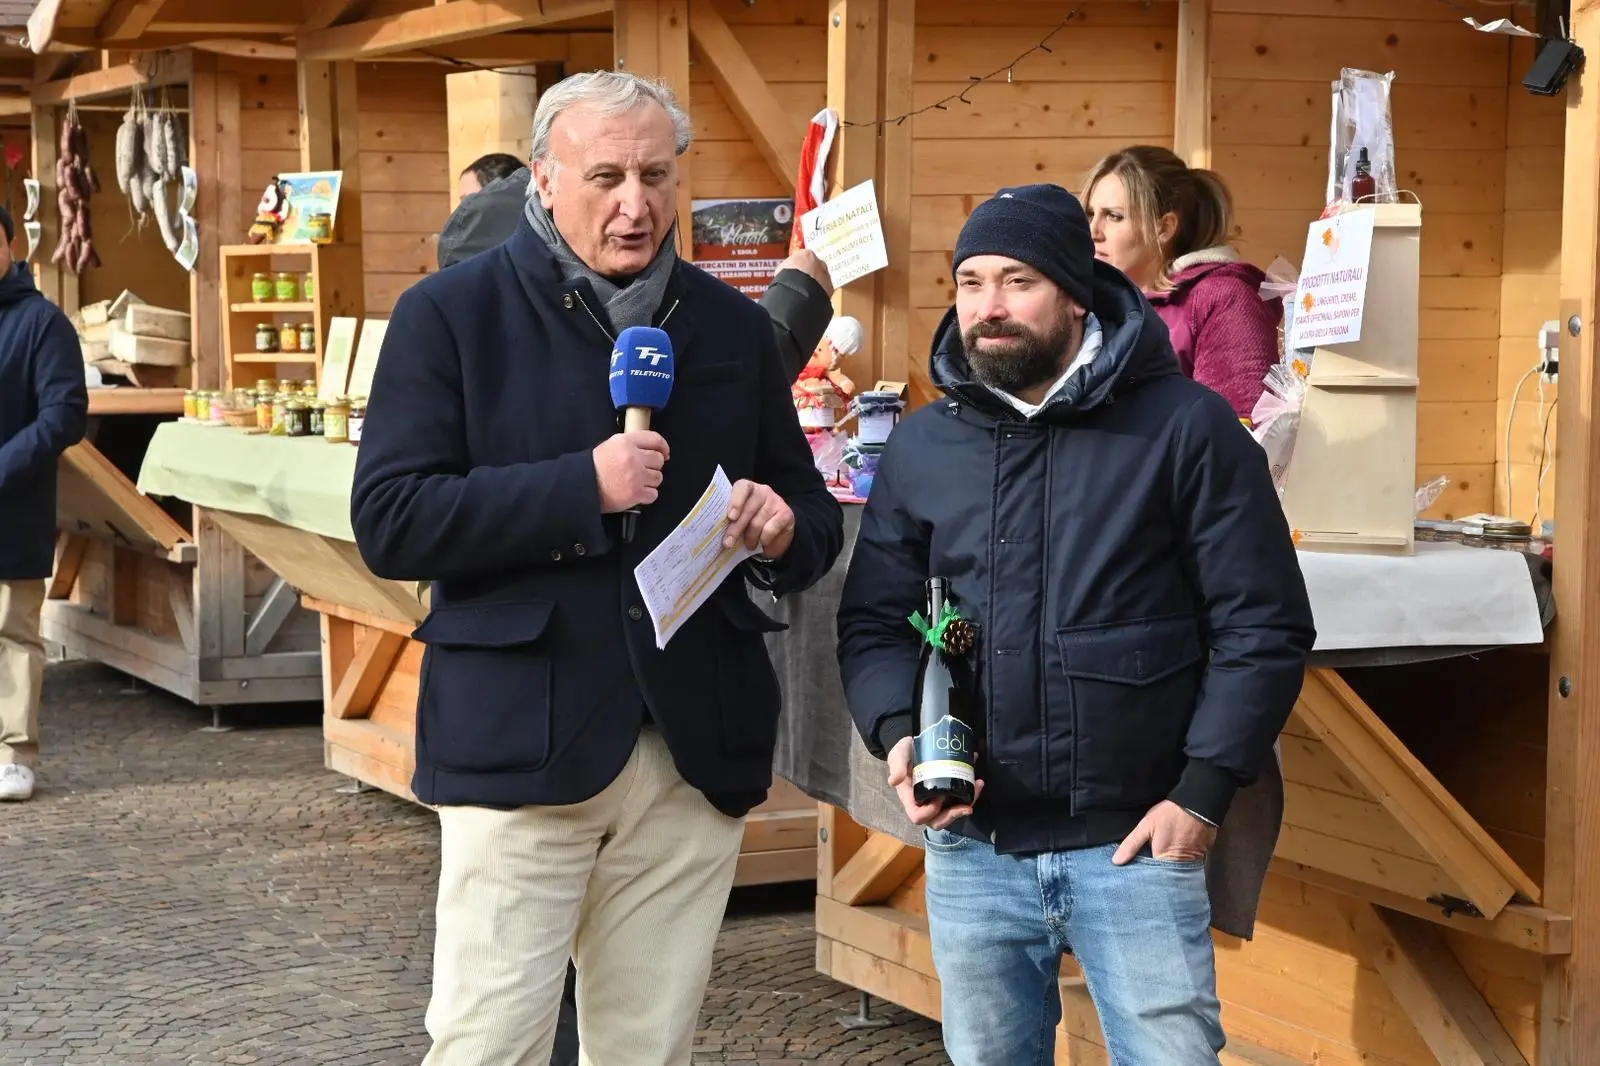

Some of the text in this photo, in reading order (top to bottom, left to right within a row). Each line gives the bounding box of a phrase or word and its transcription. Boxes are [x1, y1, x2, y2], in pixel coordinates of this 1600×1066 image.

[845, 202, 873, 220] NATALE
[1301, 268, 1362, 290] PRODOTTI NATURALI
[635, 346, 668, 366] TT
[630, 369, 670, 379] TELETUTTO
